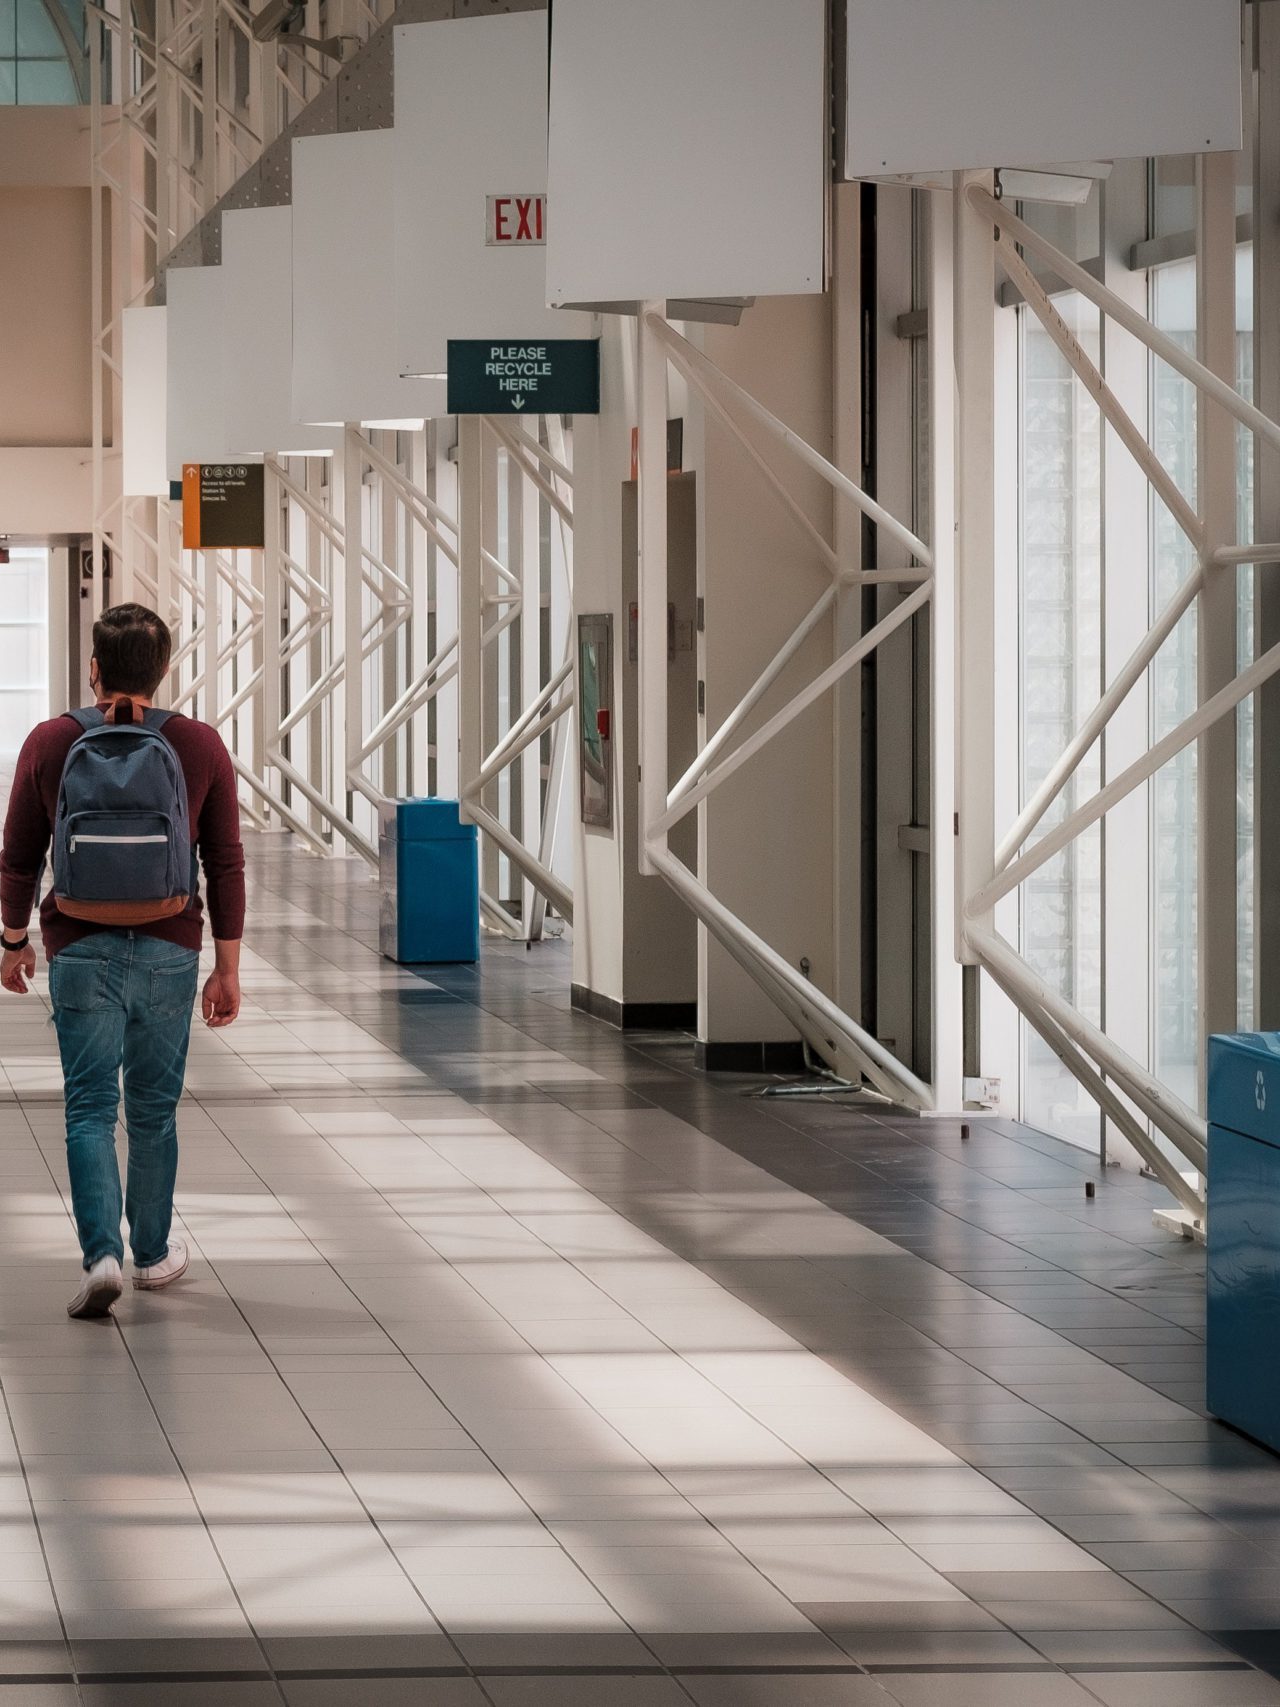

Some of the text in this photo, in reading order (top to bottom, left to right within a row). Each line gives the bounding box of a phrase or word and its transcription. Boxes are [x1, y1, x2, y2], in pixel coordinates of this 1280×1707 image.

[495, 198, 547, 240] EXI
[490, 347, 547, 360] PLEASE
[485, 363, 552, 375] RECYCLE
[499, 378, 538, 391] HERE
